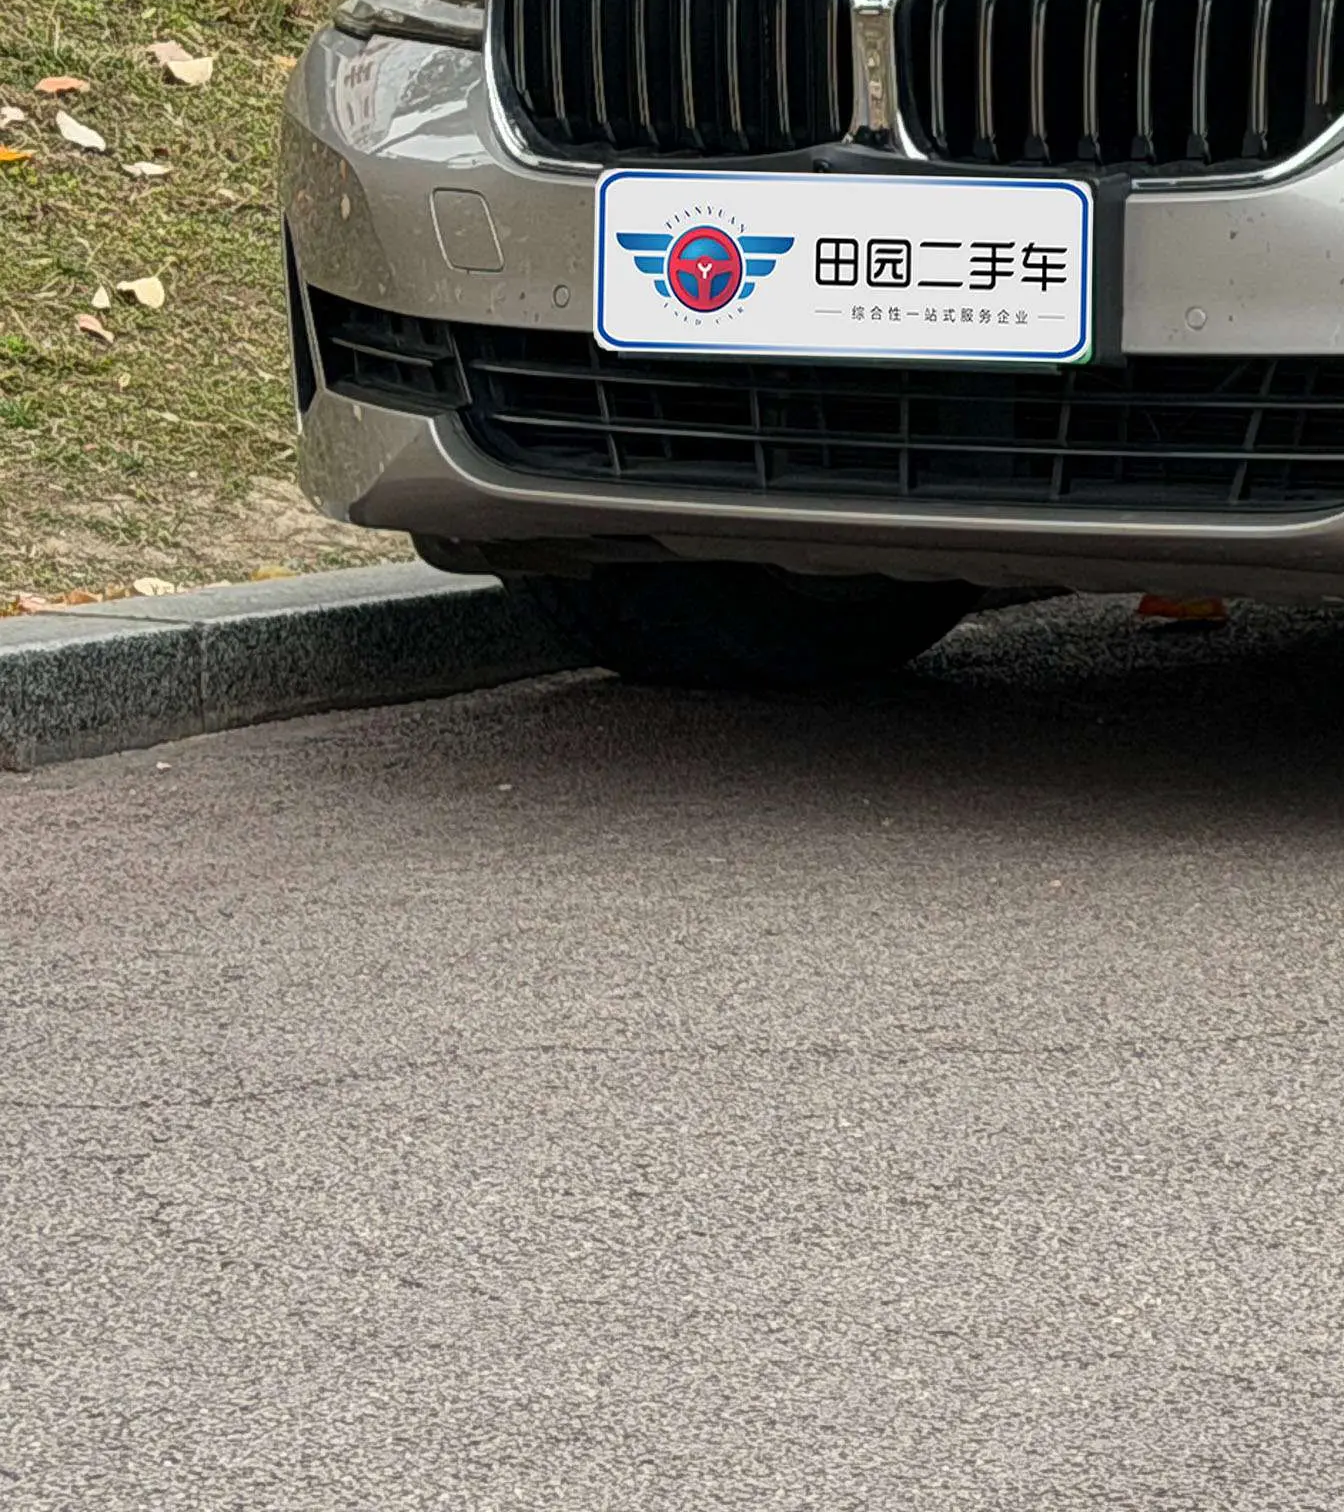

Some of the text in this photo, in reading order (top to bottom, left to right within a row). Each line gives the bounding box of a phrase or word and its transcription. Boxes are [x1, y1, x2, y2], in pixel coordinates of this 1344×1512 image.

[815, 237, 1068, 292] 田园二手车
[851, 304, 1029, 325] 综合性一站式服务企业
